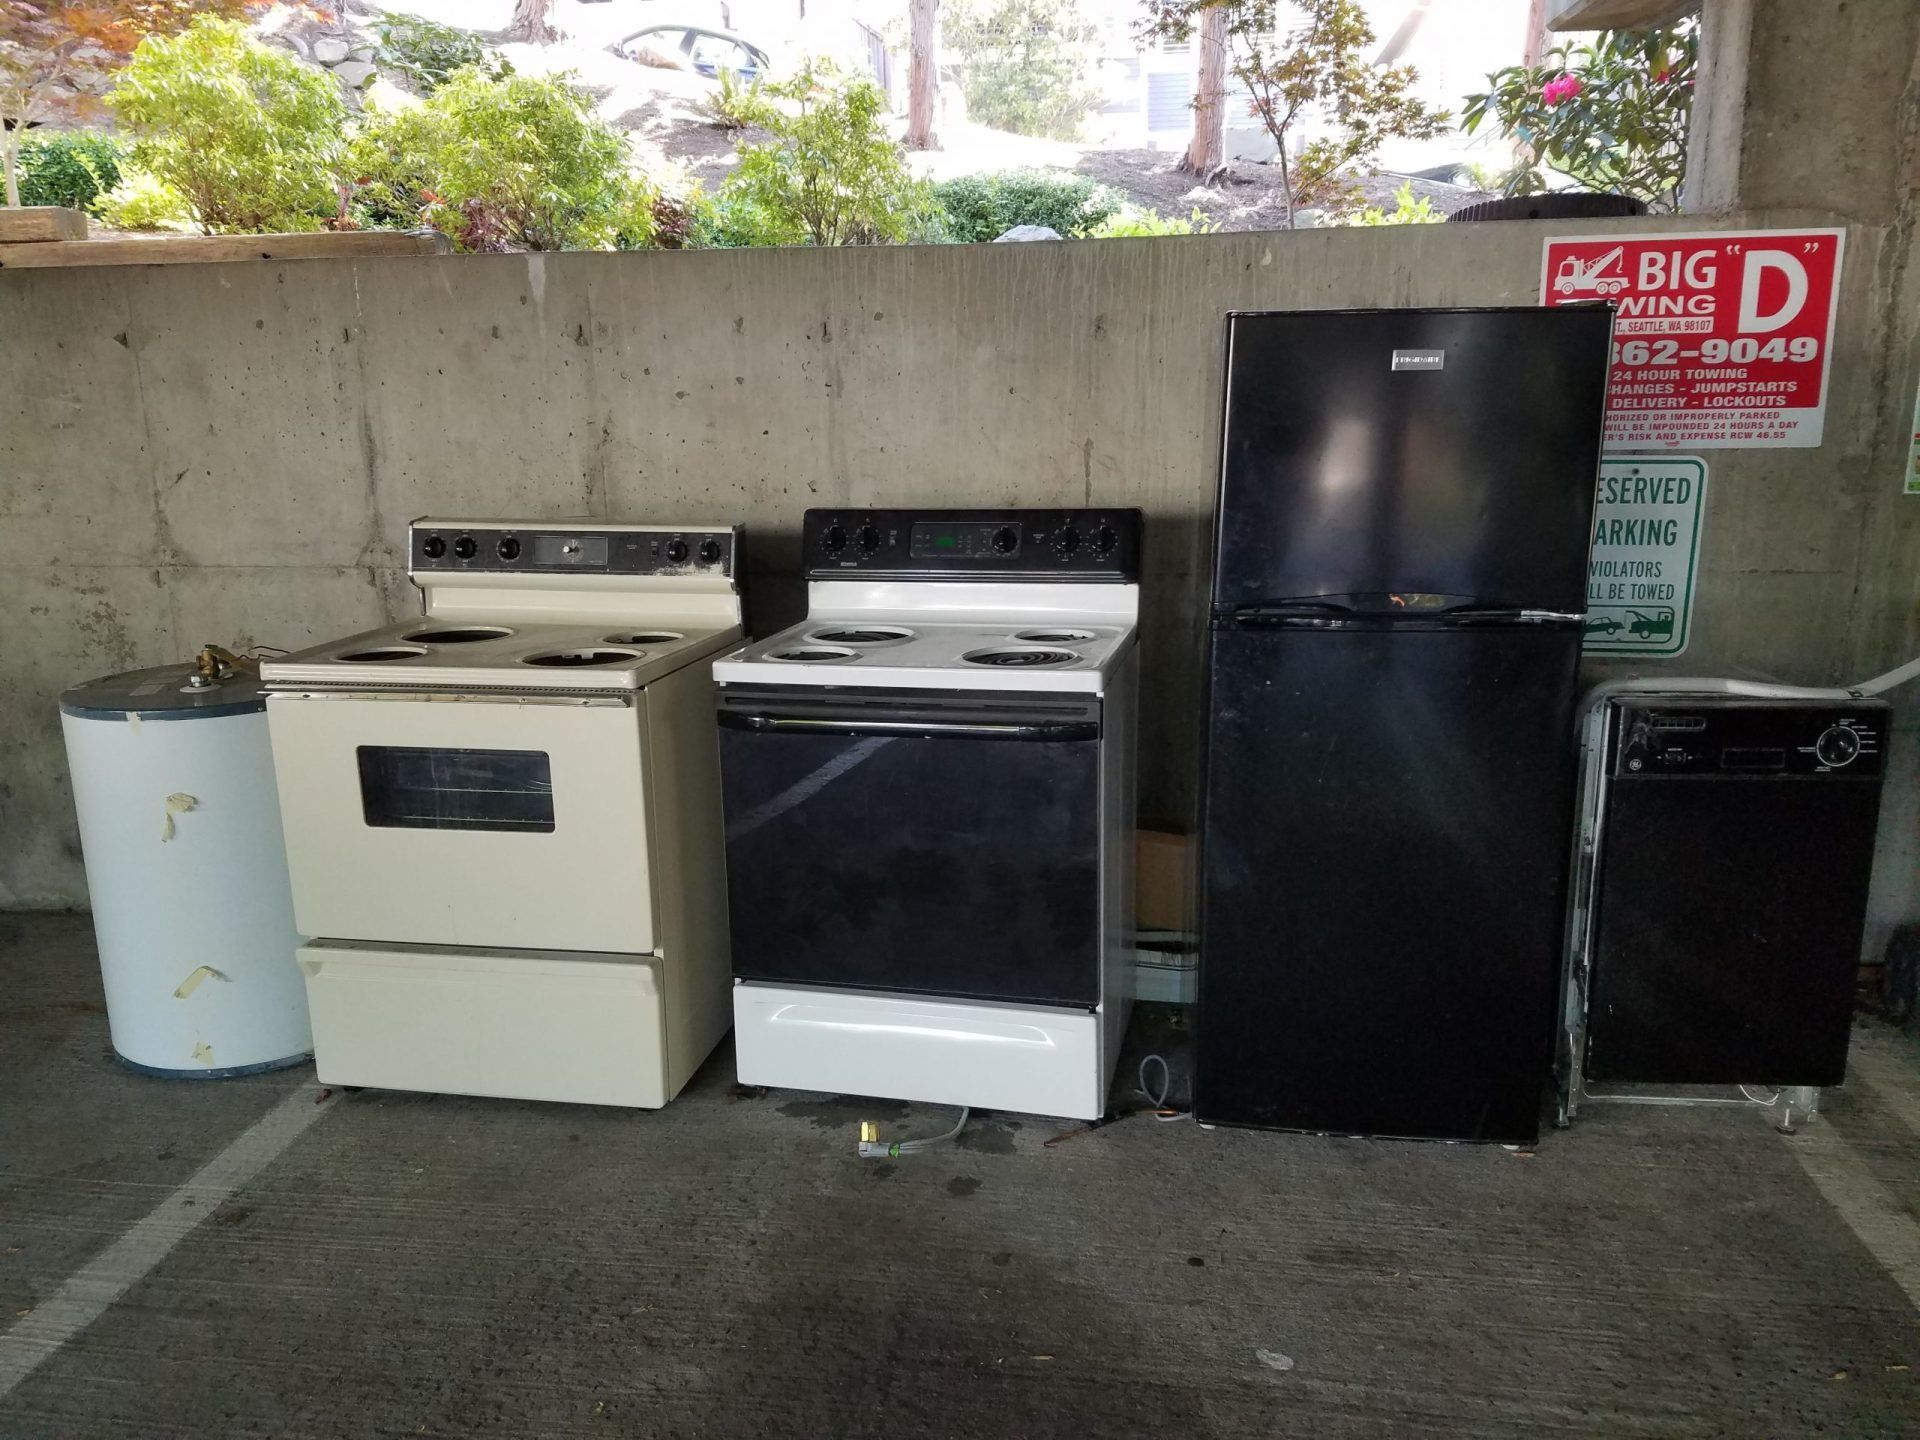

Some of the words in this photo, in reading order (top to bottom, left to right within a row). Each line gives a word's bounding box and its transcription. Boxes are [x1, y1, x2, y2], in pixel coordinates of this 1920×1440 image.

[1638, 249, 1717, 290] BIG
[1628, 321, 1665, 334] SEATTLE,
[1668, 321, 1681, 331] WA
[1684, 320, 1711, 331] 98107
[1612, 370, 1633, 381] 24
[1637, 369, 1681, 380] HOUR
[1685, 368, 1748, 380] TOWING
[1608, 383, 1675, 395] HANGES
[1691, 381, 1798, 394] JUMPSTARTS
[1612, 397, 1688, 409] DELIVERY
[1703, 395, 1787, 407] LOCKOUTS
[1606, 413, 1649, 422] HORIZED
[1653, 413, 1666, 421] OR
[1670, 412, 1735, 421] IMPROPERLY
[1739, 411, 1780, 420] PARKED
[1604, 423, 1628, 431] WILL
[1632, 423, 1645, 431] BE
[1649, 422, 1710, 431] IMPOUNDED
[1713, 422, 1726, 430] 24
[1729, 421, 1765, 430] HOURS
[1768, 421, 1775, 429] A
[1778, 421, 1799, 429] DAY
[1603, 433, 1624, 441] ER'S
[1656, 432, 1677, 440] AND
[1680, 431, 1727, 440] EXPENSE
[1730, 431, 1754, 439] RCW
[1756, 431, 1786, 439] 46.55
[1597, 477, 1691, 504] ESERVED
[1593, 519, 1678, 546] ARKING
[1590, 560, 1662, 578] VIOLATORS
[1589, 583, 1602, 599] LL
[1608, 583, 1625, 600] BE
[1630, 583, 1675, 600] TOWED
